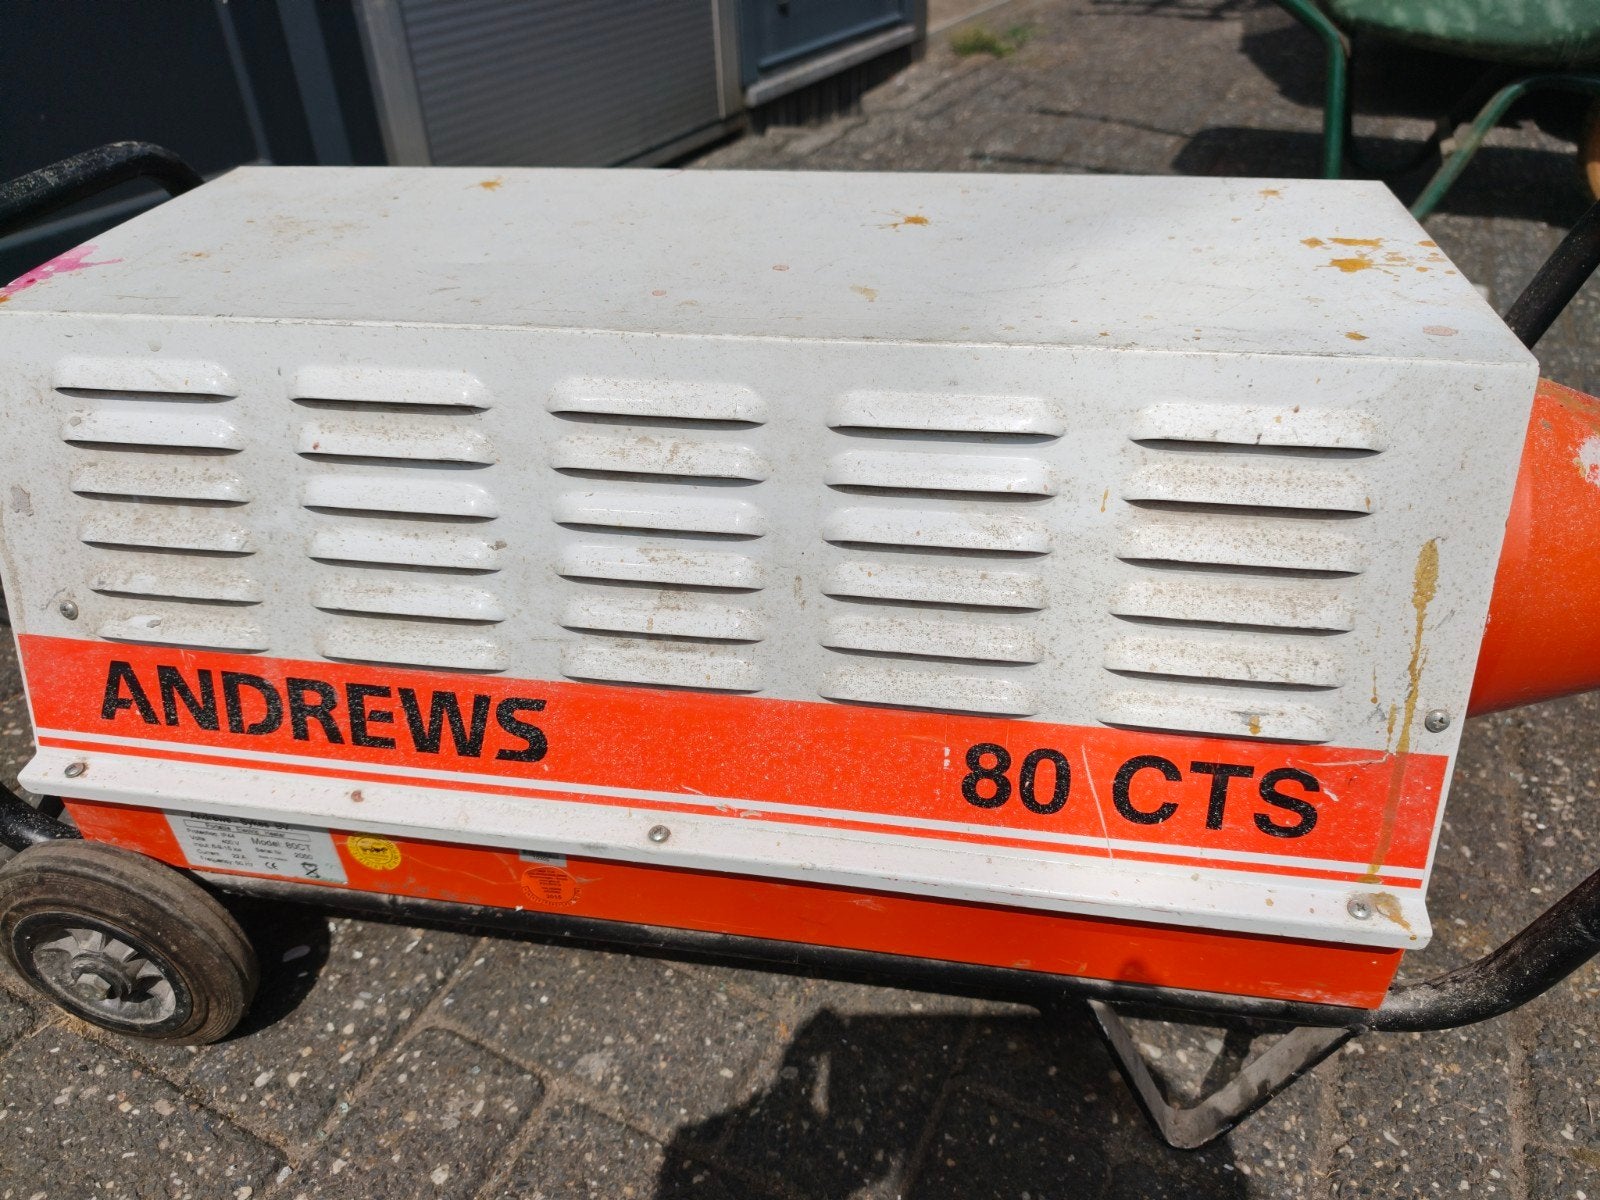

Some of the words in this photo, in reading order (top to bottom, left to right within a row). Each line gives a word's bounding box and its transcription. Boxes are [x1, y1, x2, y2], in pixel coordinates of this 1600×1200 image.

[101, 661, 548, 762] ANDREWS
[961, 742, 1071, 814] 80
[1112, 754, 1320, 838] CTS
